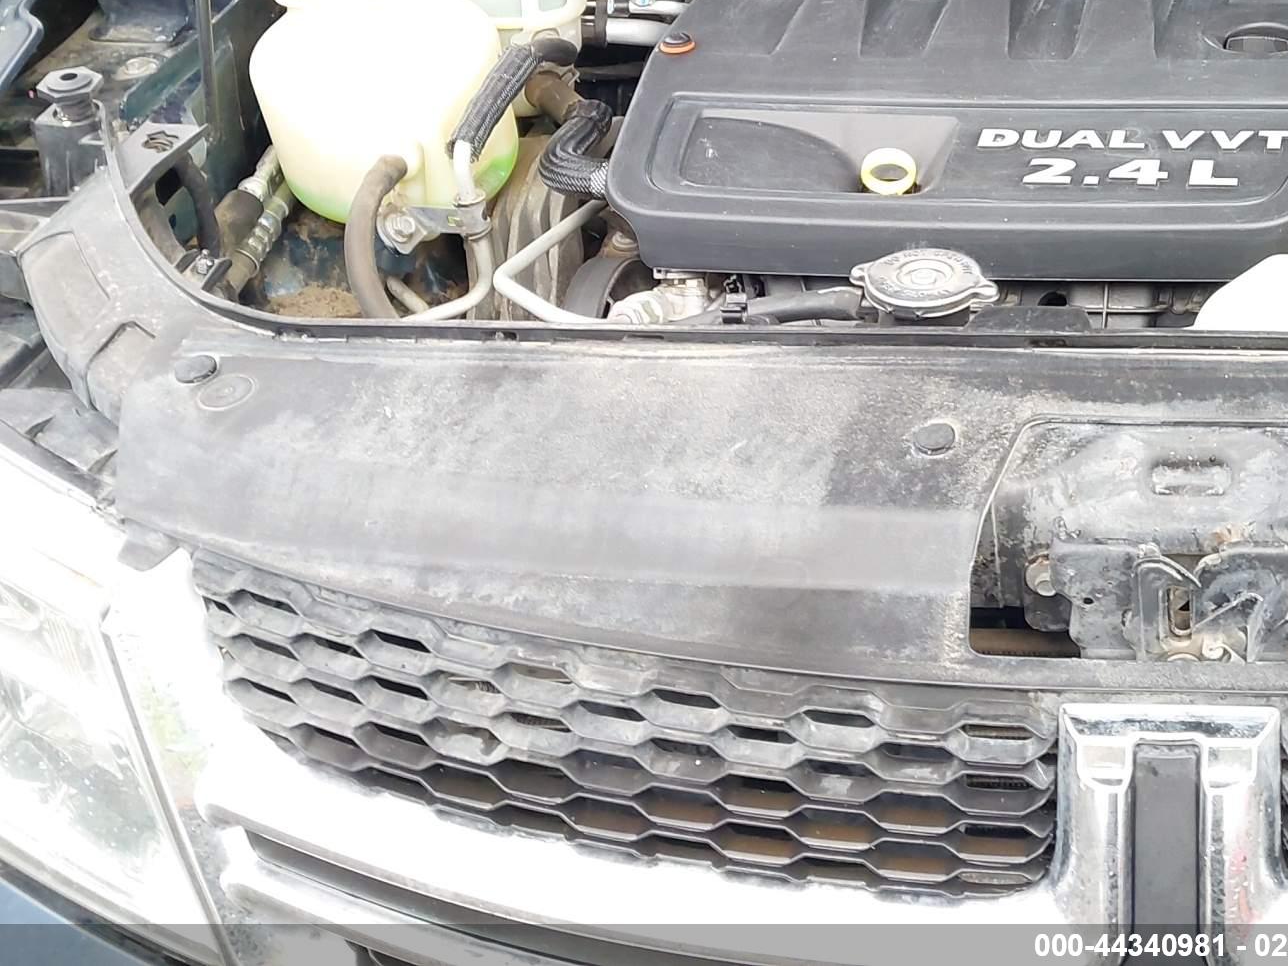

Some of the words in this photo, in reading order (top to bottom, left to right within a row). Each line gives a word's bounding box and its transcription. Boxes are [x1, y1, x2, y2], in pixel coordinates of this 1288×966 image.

[977, 128, 1145, 149] DUAL
[1022, 158, 1169, 186] 2.4
[1187, 159, 1239, 186] L
